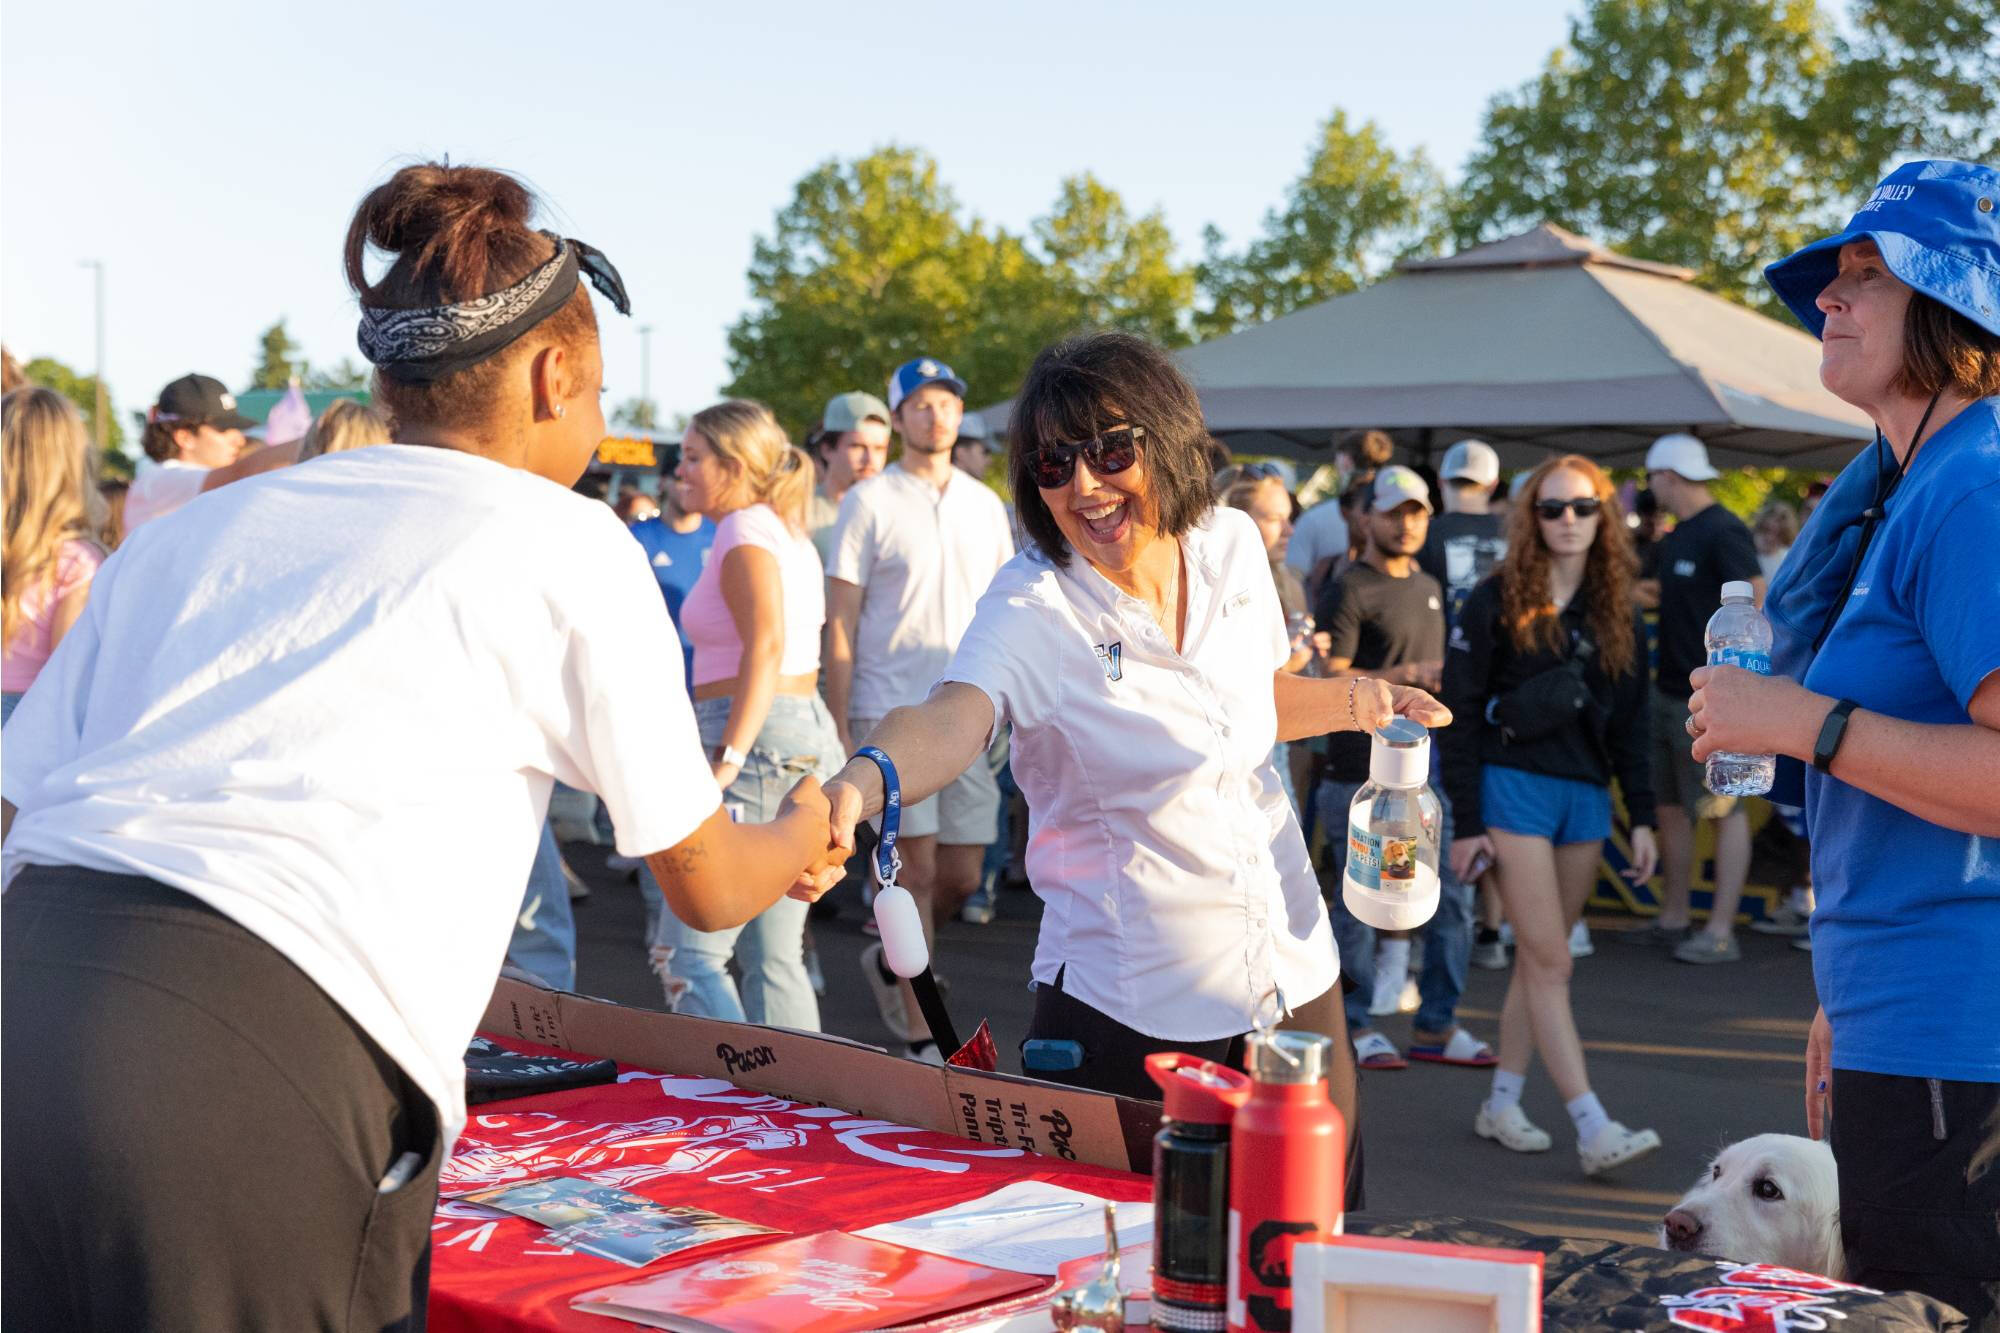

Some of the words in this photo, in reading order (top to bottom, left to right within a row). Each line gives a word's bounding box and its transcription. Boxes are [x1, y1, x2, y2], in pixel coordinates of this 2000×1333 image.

[1877, 184, 1916, 201] VALLEY
[888, 789, 900, 808] GV
[883, 831, 896, 845] GV
[716, 1043, 777, 1075] Pacon
